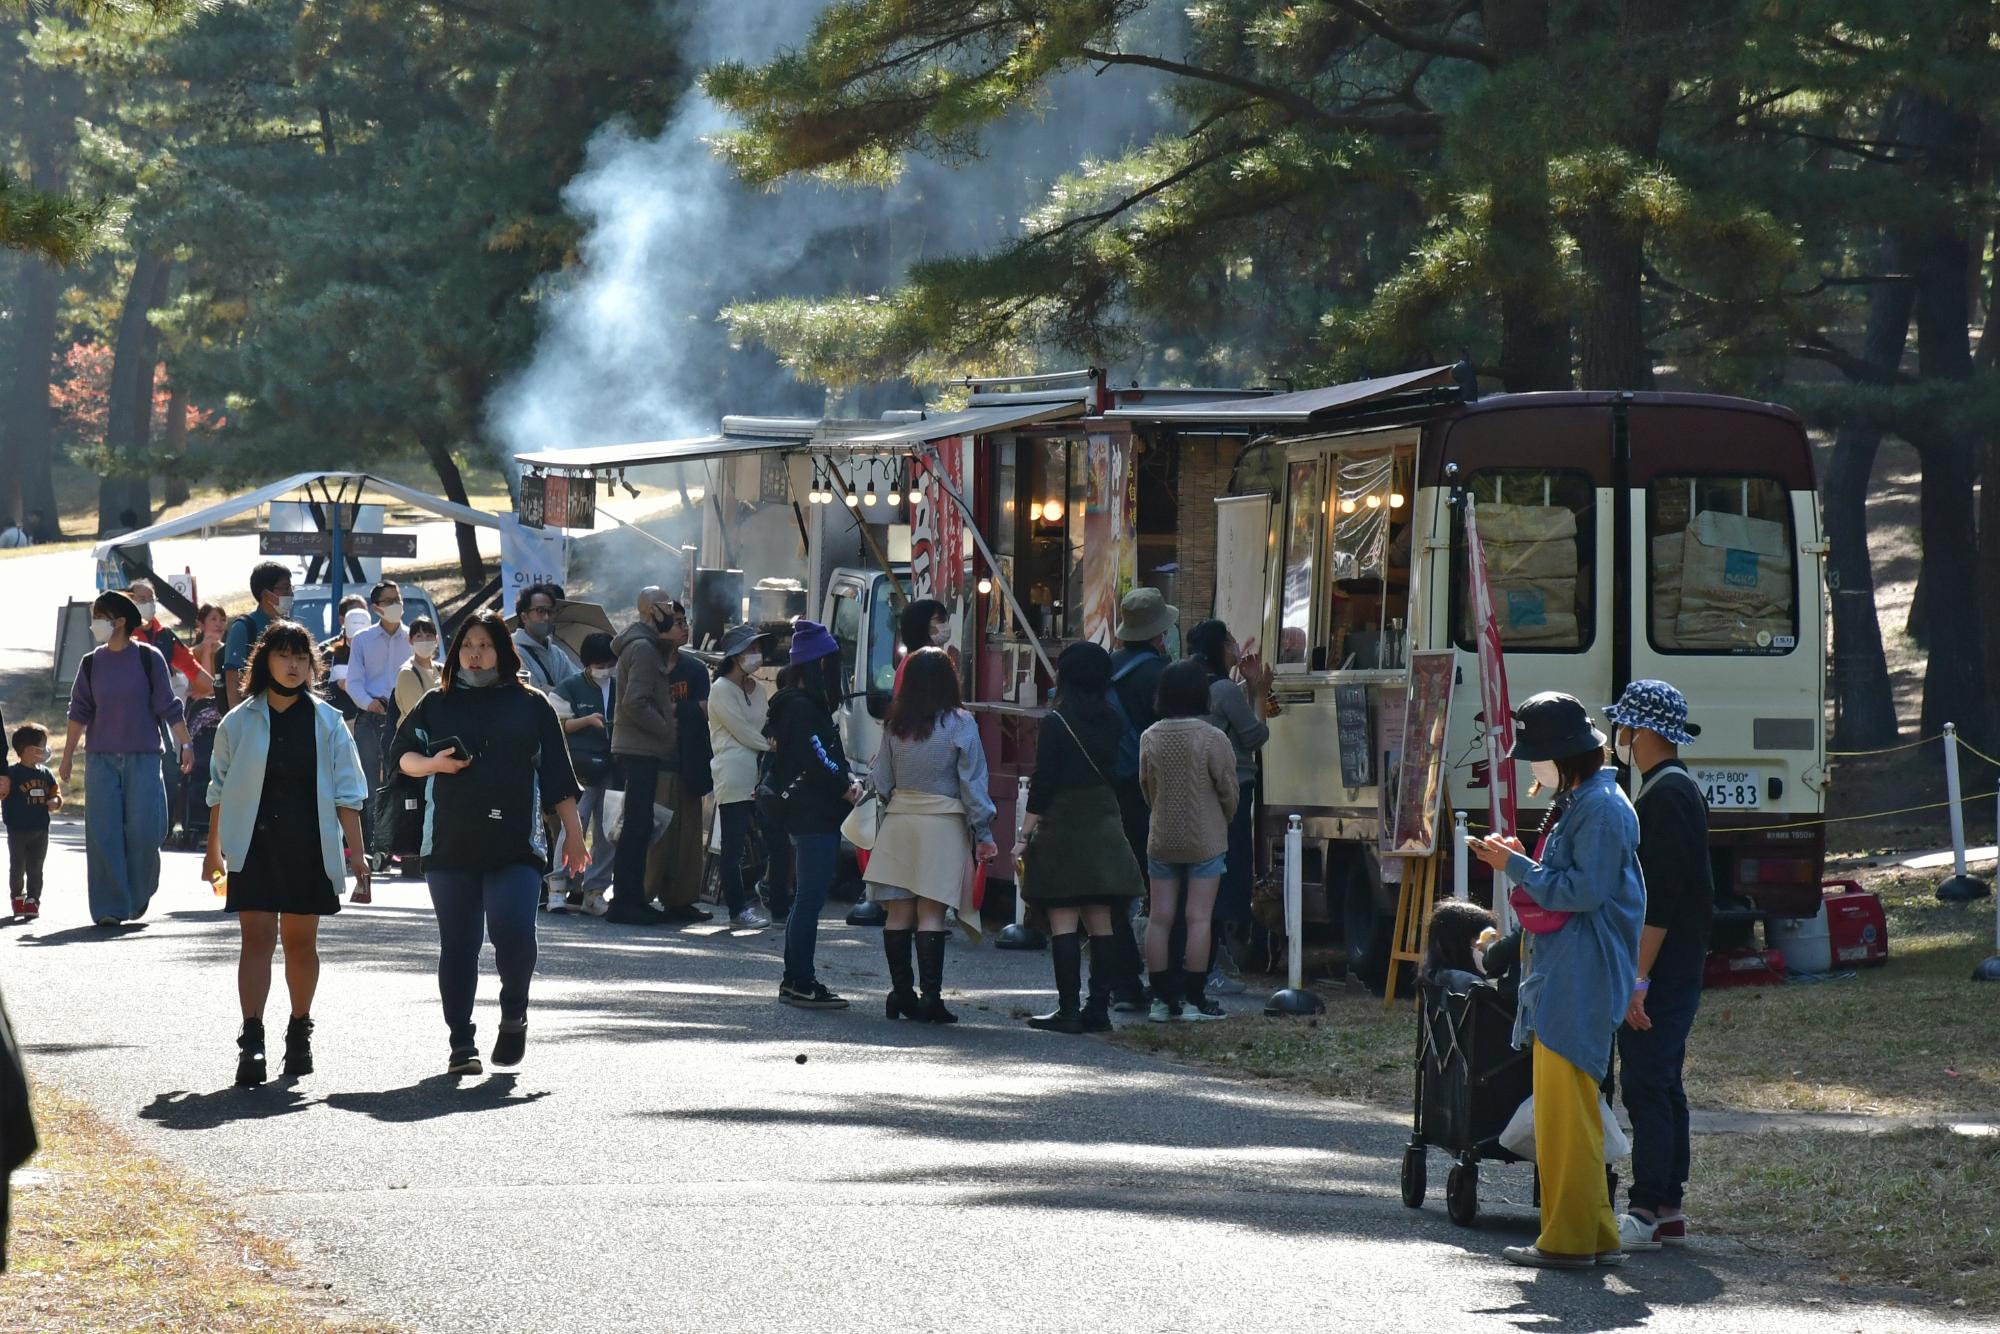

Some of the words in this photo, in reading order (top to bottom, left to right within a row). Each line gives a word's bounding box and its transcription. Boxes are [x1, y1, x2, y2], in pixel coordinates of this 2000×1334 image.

[1705, 772, 1726, 783] 水戸
[1726, 772, 1745, 783] 800
[1705, 785, 1757, 805] 45-83
